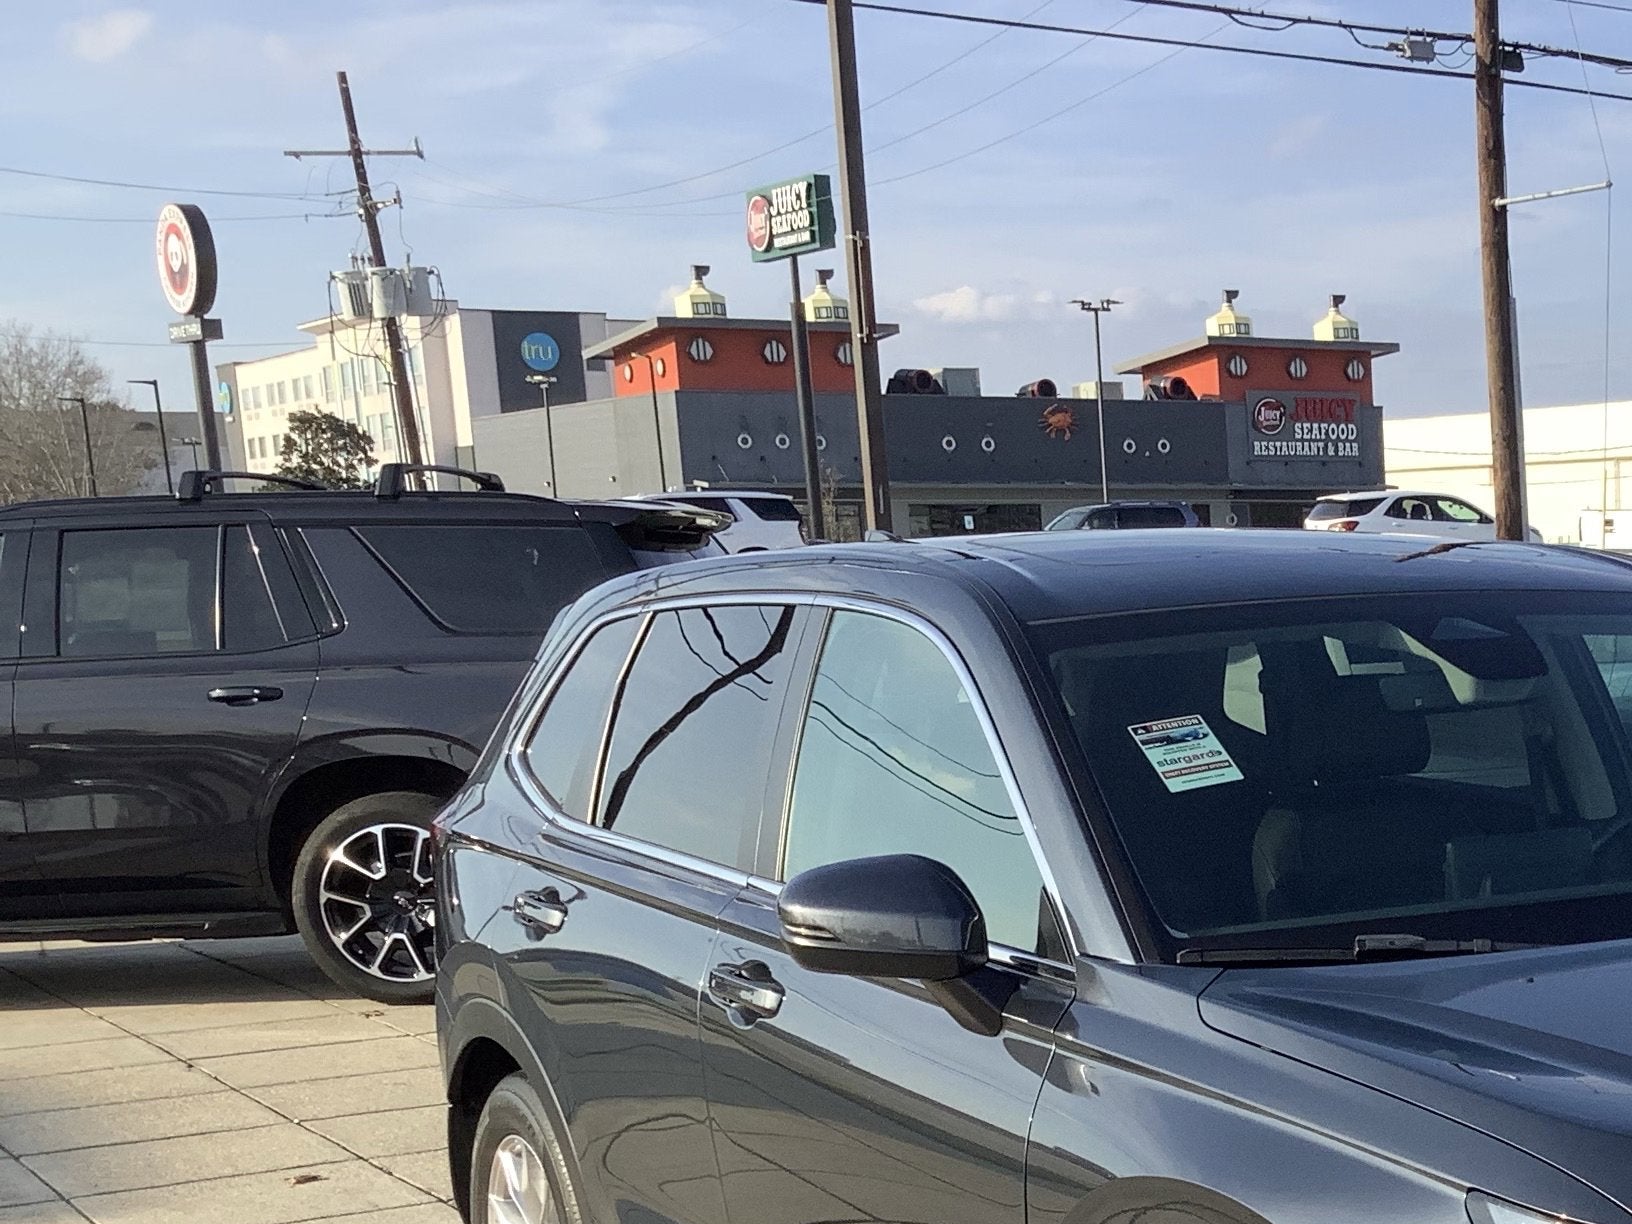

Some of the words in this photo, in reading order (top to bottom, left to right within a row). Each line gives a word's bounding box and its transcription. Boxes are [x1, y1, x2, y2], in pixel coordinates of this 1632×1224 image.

[770, 181, 808, 216] JUICY
[771, 209, 810, 235] SEAFOOD
[521, 340, 552, 360] tru
[1291, 397, 1356, 422] JUICY
[1294, 422, 1357, 440] SEAFOOD
[1253, 441, 1325, 456] RESTAURANT
[1327, 442, 1336, 456] &
[1338, 442, 1359, 456] BAR
[1151, 718, 1199, 732] ATTENTION
